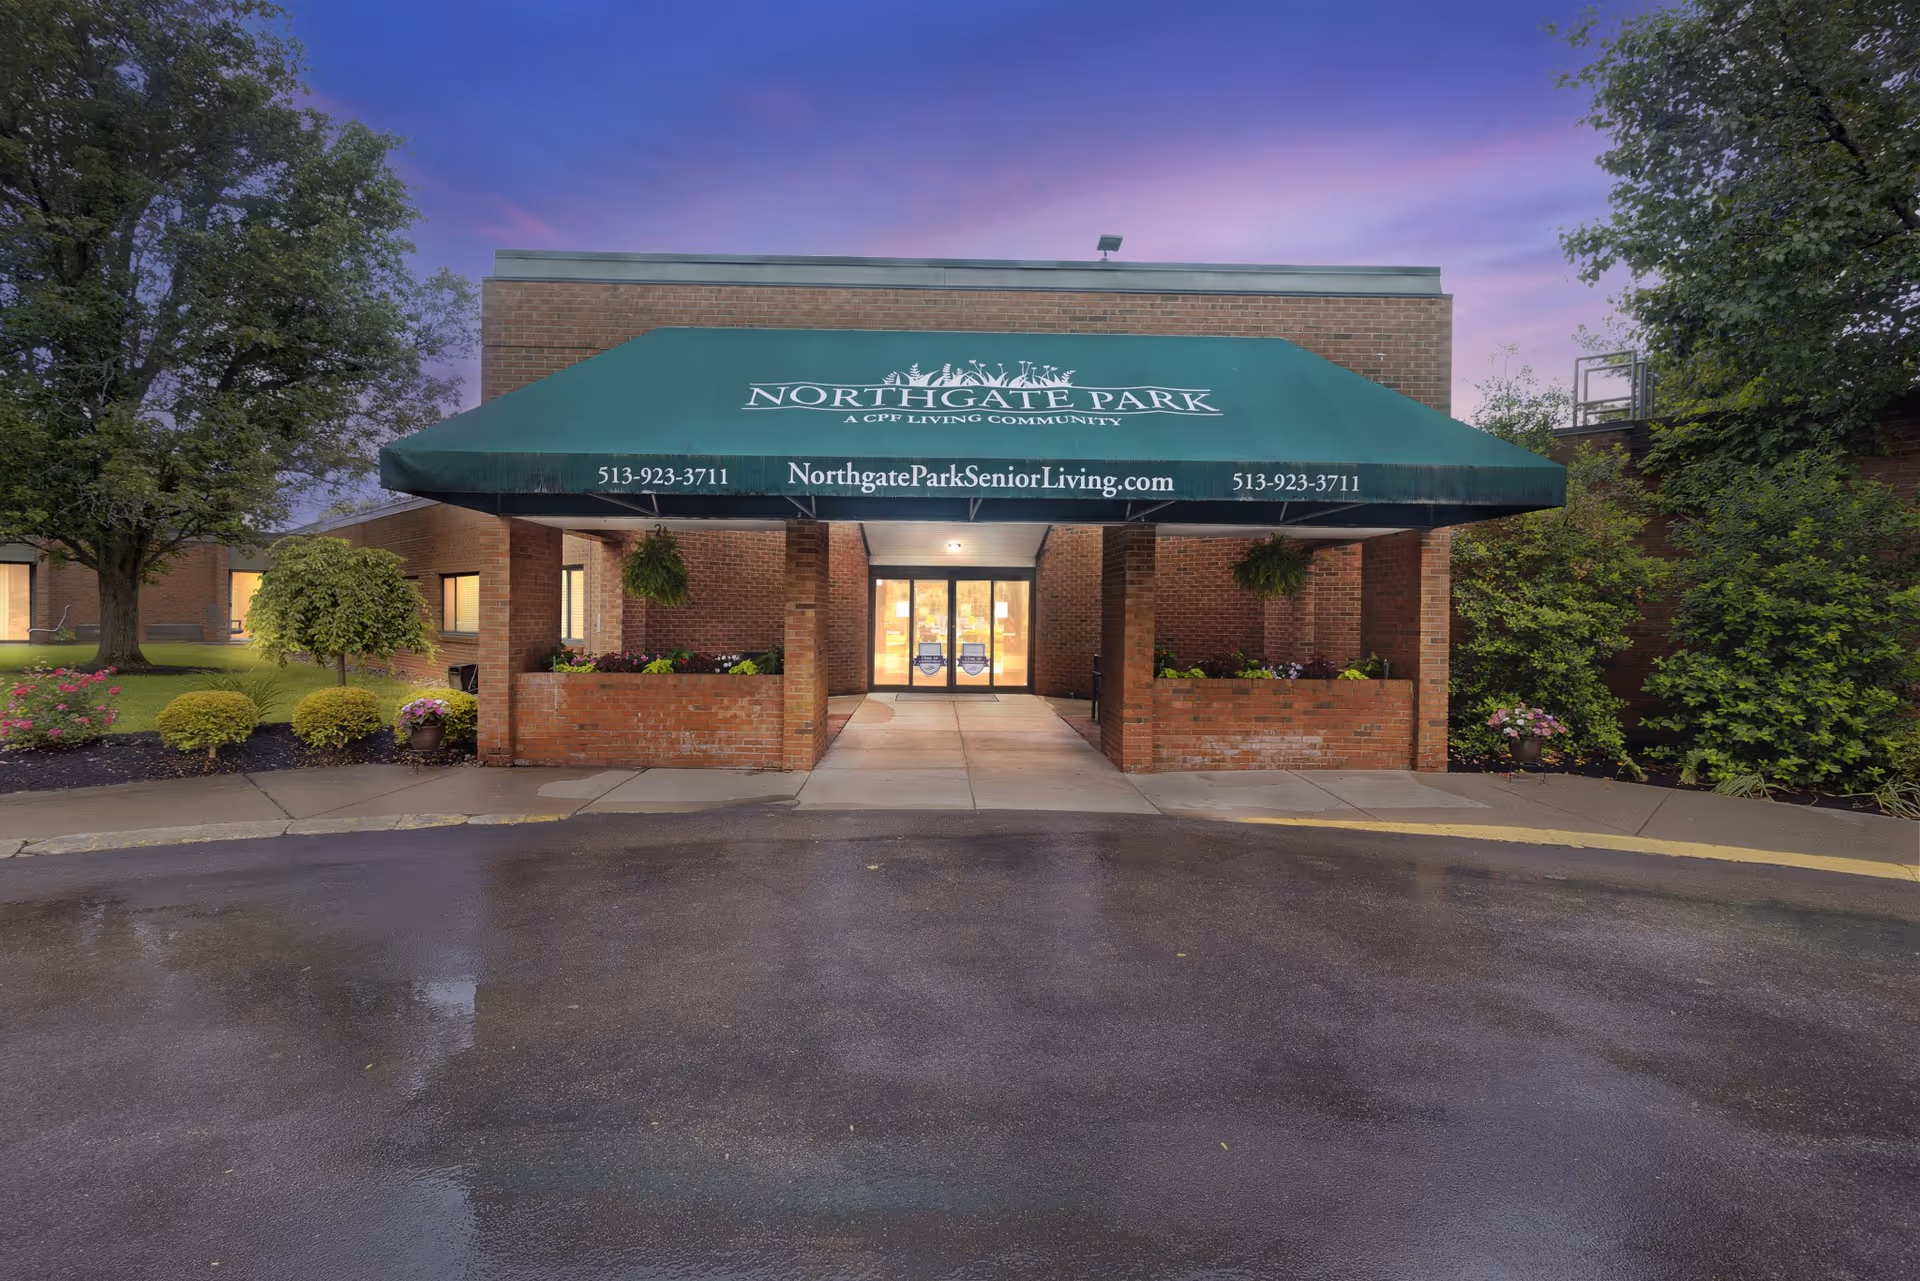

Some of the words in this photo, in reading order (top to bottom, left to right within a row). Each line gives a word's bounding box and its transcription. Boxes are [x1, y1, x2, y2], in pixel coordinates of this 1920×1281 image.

[745, 385, 1075, 409] NORTHGATE
[1087, 389, 1221, 412] PARK
[843, 414, 858, 424] A
[863, 413, 903, 424] CPF
[907, 413, 982, 424] LIVING
[987, 415, 1123, 426] COMMUNITY
[598, 466, 729, 486] 513-923-3711
[787, 461, 1175, 498] NorthgateParkSeniorLiving.com
[1232, 472, 1361, 492] 513-923-3711
